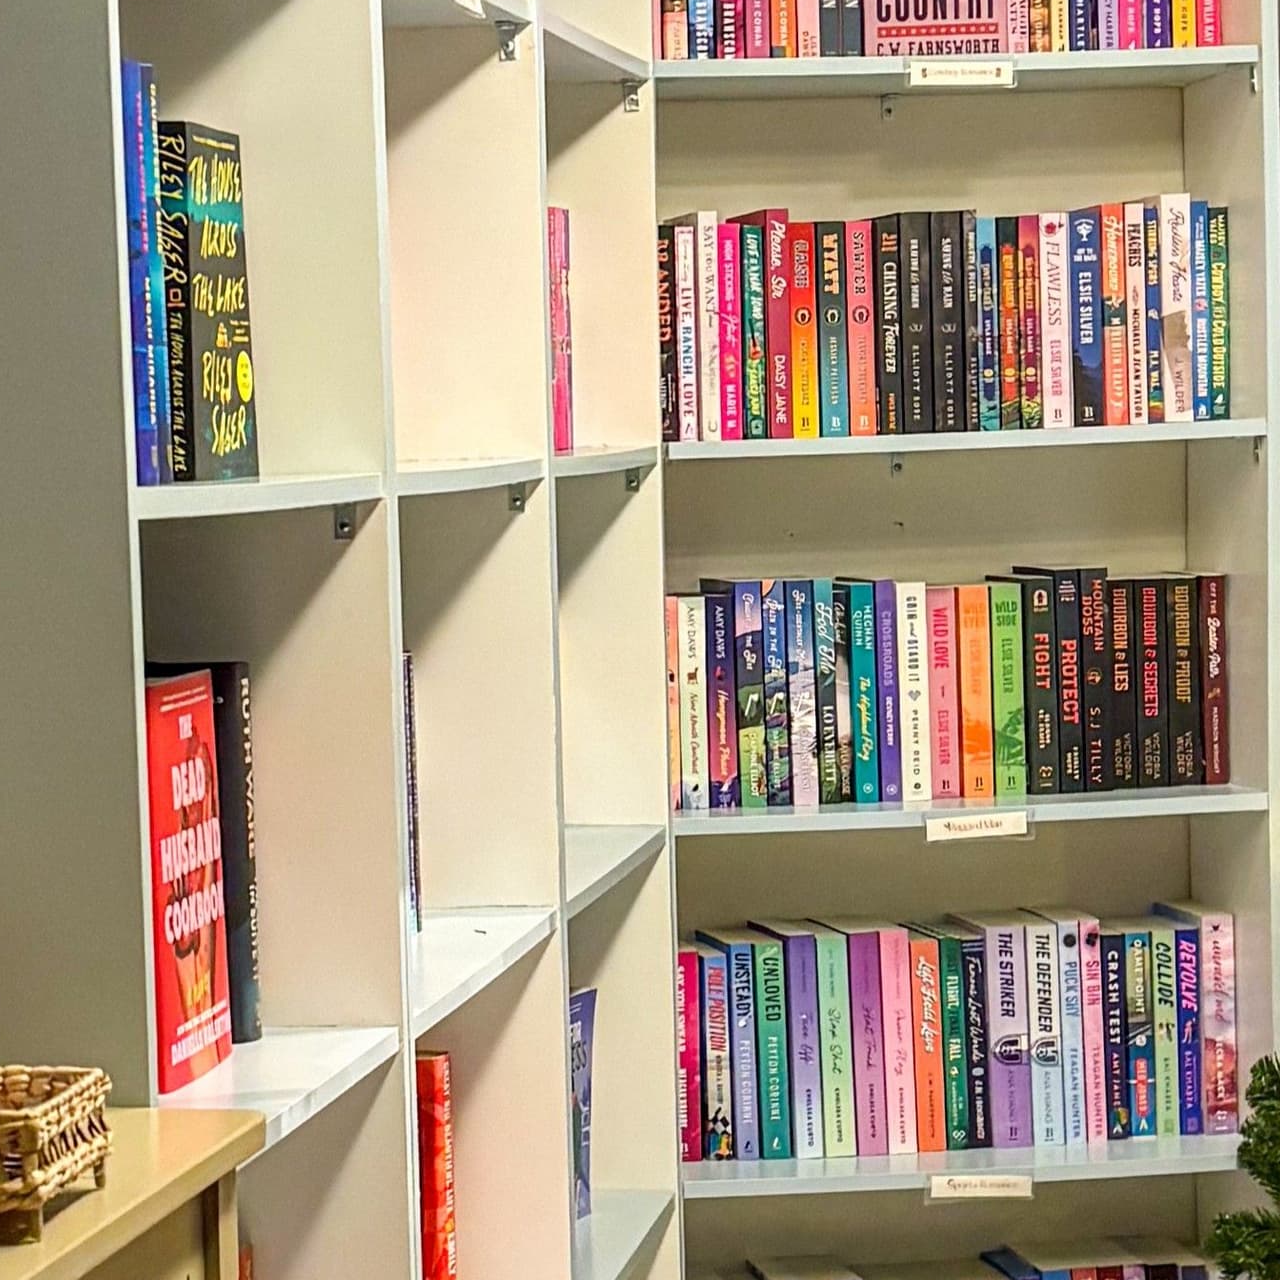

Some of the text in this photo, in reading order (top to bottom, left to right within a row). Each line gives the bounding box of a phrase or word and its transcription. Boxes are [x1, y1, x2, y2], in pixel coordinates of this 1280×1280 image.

[158, 133, 186, 284] RILEY SAGER
[187, 151, 243, 205] THE HOUSE
[199, 213, 238, 259] ACROSS
[823, 233, 839, 294] WYATT
[852, 231, 866, 294] SAWYER
[1127, 223, 1141, 268] PEACHES
[191, 272, 247, 318] THE LAKE
[1046, 241, 1062, 327] FLAWLESS
[1079, 272, 1093, 345] ELSIE SILVER
[883, 262, 900, 373] CHASING FOREVER
[201, 348, 232, 403] RILEY
[775, 355, 786, 423] DAISY JANE
[1050, 340, 1062, 396] ELSIE SILVER
[1132, 308, 1144, 418] MICHAELA JEAN TAYLOR
[1175, 371, 1185, 413] WILDER
[210, 404, 248, 456] SAGER
[683, 384, 694, 417] LOVE
[687, 606, 696, 659] AMY DAWS
[714, 605, 726, 659] AMY DAWS
[815, 602, 833, 637] Fool
[932, 608, 949, 669] WILD LOVE
[1082, 596, 1093, 636] BOSS
[1092, 579, 1104, 651] MOUNTAIN
[1112, 588, 1128, 691] BOURBON LIES
[1174, 585, 1191, 703] BOURBON PROOF
[881, 611, 893, 686] CROSSROADS
[1034, 633, 1051, 689] FIGHT
[1142, 587, 1158, 717] BOURBON SECRETS
[1060, 639, 1079, 724] PROTECT
[177, 712, 194, 740] THE
[822, 706, 837, 783] LO EVERETT
[169, 755, 206, 811] DEAD
[240, 677, 256, 859] RUTH WARE
[1091, 739, 1102, 783] TILLY
[159, 816, 222, 884] HUSBAND
[164, 878, 226, 947] COOKBOOK
[734, 953, 751, 1019] UNSTEADY
[762, 957, 781, 1021] UNLOVED
[998, 933, 1015, 1017] THE STRIKER
[1035, 934, 1052, 1032] THE DEFENDER
[1064, 961, 1080, 1017] PUCK SHY
[1085, 960, 1101, 1006] SIN BIN
[1107, 950, 1120, 1044] CRASH TEST
[1134, 980, 1145, 1013] POINT
[1155, 942, 1174, 1008] COLLIDE
[1179, 939, 1198, 1012] REVOLVE
[708, 966, 726, 1052] POLE POSITION
[767, 1036, 781, 1121] PEYTON CORINNE
[949, 1038, 962, 1061] FALL
